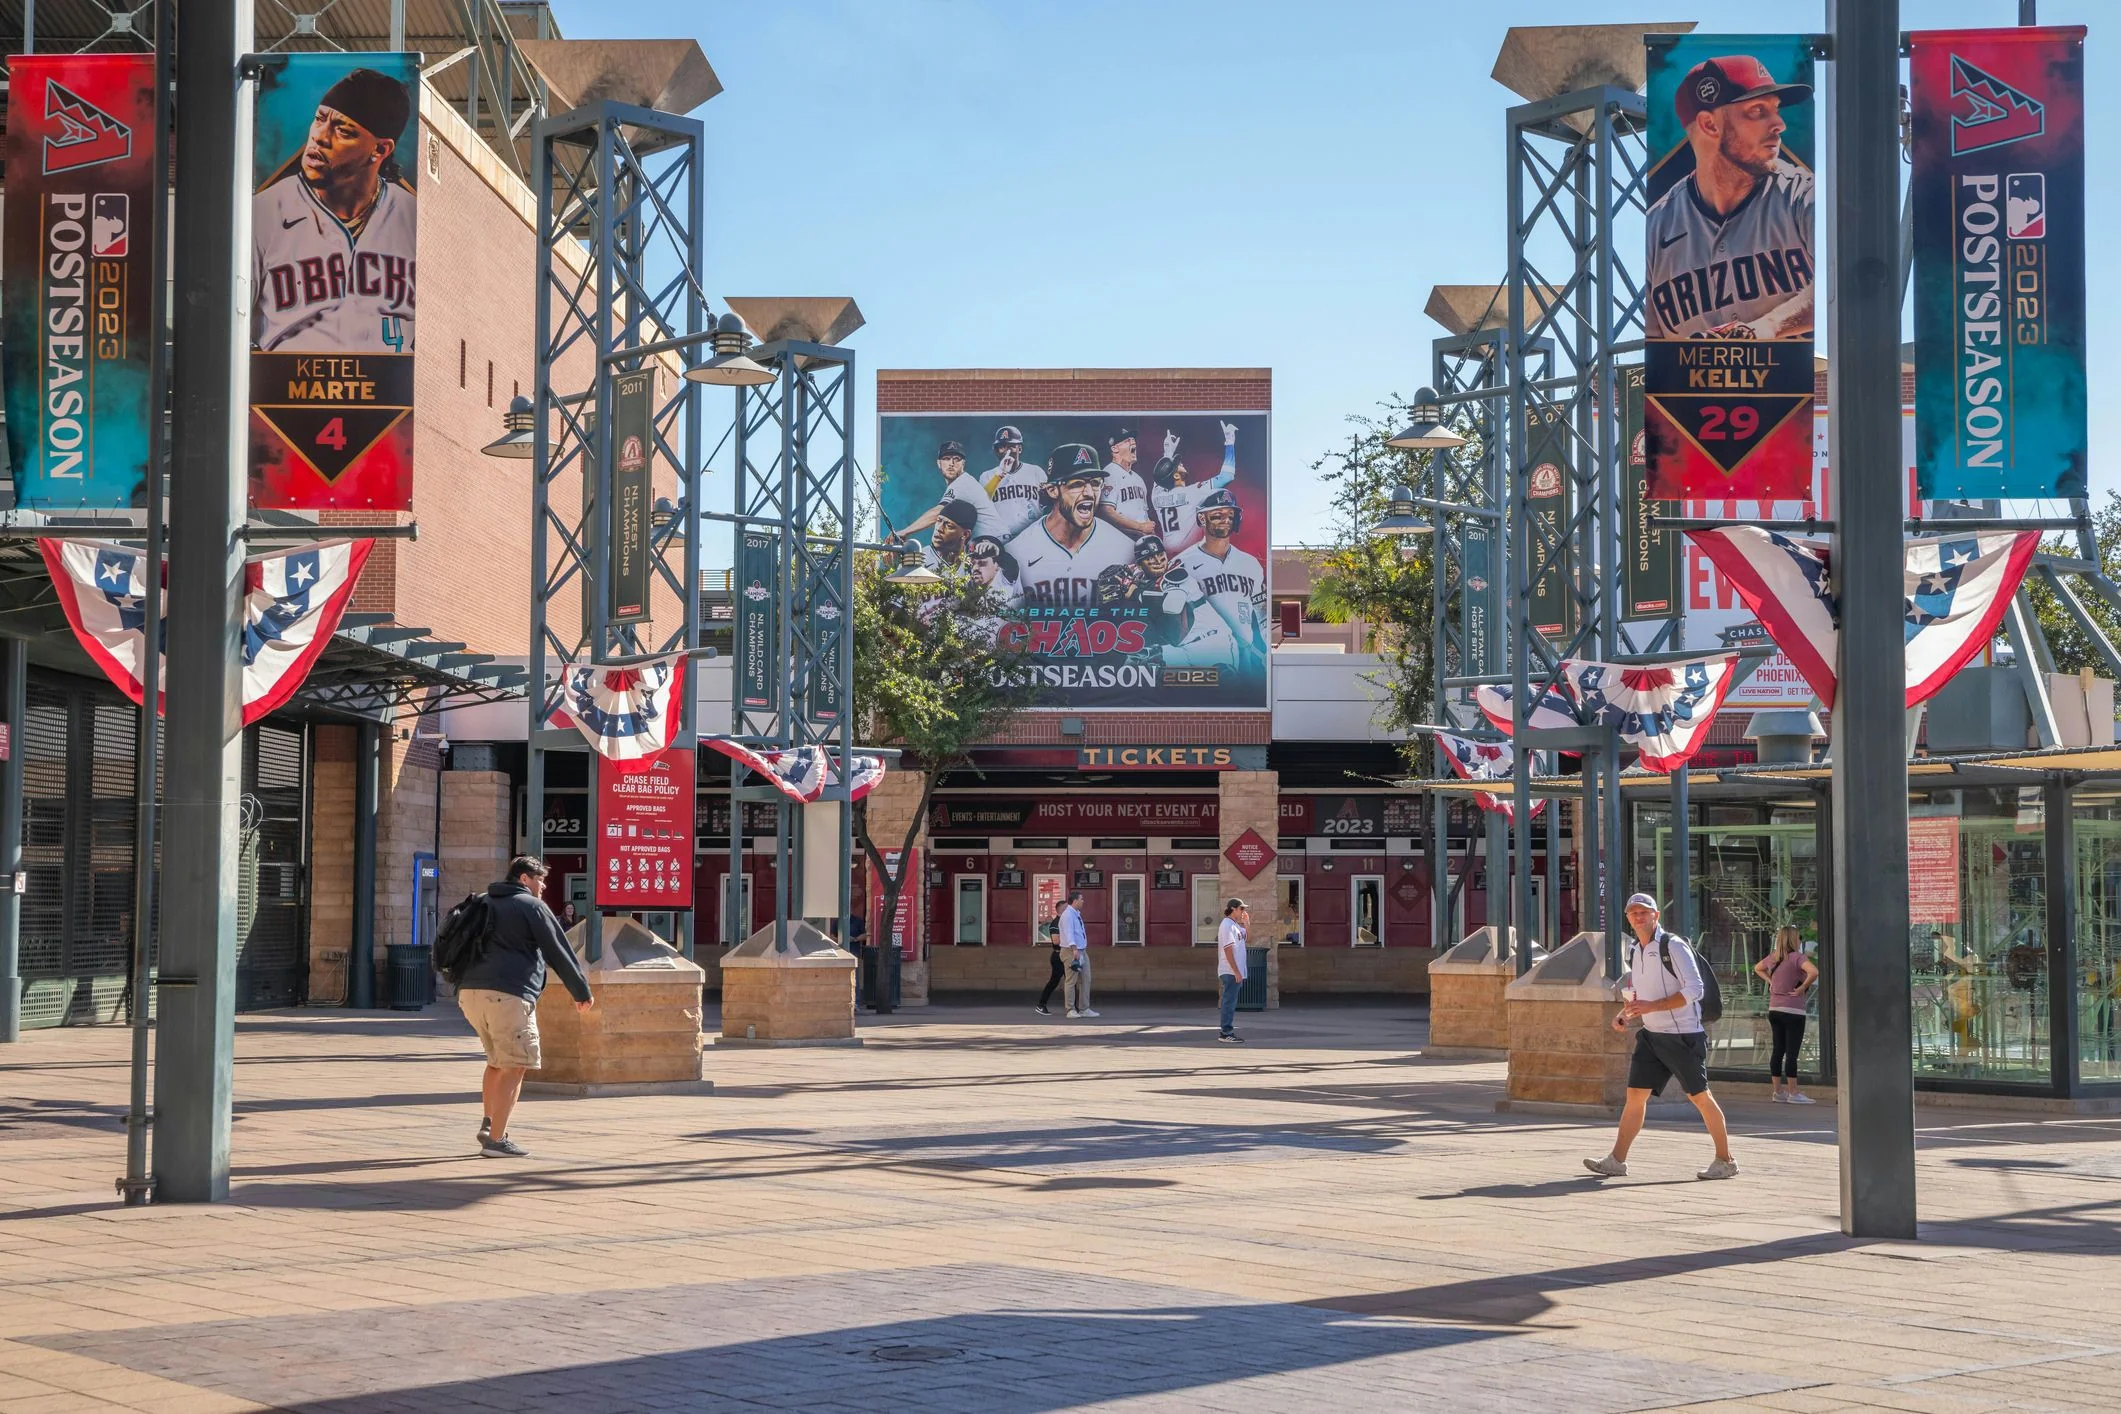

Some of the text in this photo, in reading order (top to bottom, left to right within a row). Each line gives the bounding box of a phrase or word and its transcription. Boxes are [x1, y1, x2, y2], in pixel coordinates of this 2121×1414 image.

[1700, 82, 1714, 97] 25
[1653, 248, 1812, 334] ARIZONA
[2015, 244, 2038, 346] 2023
[97, 262, 120, 361] 2023
[1962, 173, 2003, 470] POSTSEASON
[48, 193, 86, 481] POSTSEASON
[1678, 347, 1780, 366] MERRILL
[296, 359, 368, 378] KETEL
[1689, 370, 1770, 388] KELLY
[287, 381, 376, 400] MARTE
[621, 382, 643, 395] 2011
[1698, 406, 1760, 440] 29
[315, 417, 348, 451] 4
[632, 486, 639, 506] NL
[1160, 507, 1180, 532] 12
[1651, 502, 1660, 545] WST
[622, 486, 631, 576] CHAMPIONS
[631, 508, 639, 551] WEST
[1468, 531, 1485, 541] 2011
[746, 539, 769, 549] 2017
[1547, 534, 1556, 573] WT
[757, 613, 764, 629] NL
[1111, 608, 1149, 617] THE
[748, 612, 756, 677] CHAMPIONS
[997, 618, 1148, 657] CHAOS
[756, 660, 764, 691] CARD
[991, 665, 1219, 688] OSTSEASON 2023
[1756, 669, 1805, 683] PHOENIX,
[1083, 748, 1233, 765] TICKETS
[624, 775, 669, 786] CHASE FIELD
[613, 784, 680, 795] CLEAR BAG POLICY
[626, 804, 666, 813] APPROVED BAGS
[952, 812, 1021, 822] EVENTS ENTERTAINMENT
[1039, 804, 1217, 816] HOST YOUR NEXT EVENT AT
[544, 818, 580, 833] 023
[1323, 819, 1374, 833] 2023
[966, 857, 975, 869] 6
[1045, 858, 1054, 870] 7
[1124, 858, 1133, 869] 8
[1203, 858, 1212, 869] 9
[1280, 858, 1294, 869] 10
[1363, 858, 1375, 870] 11
